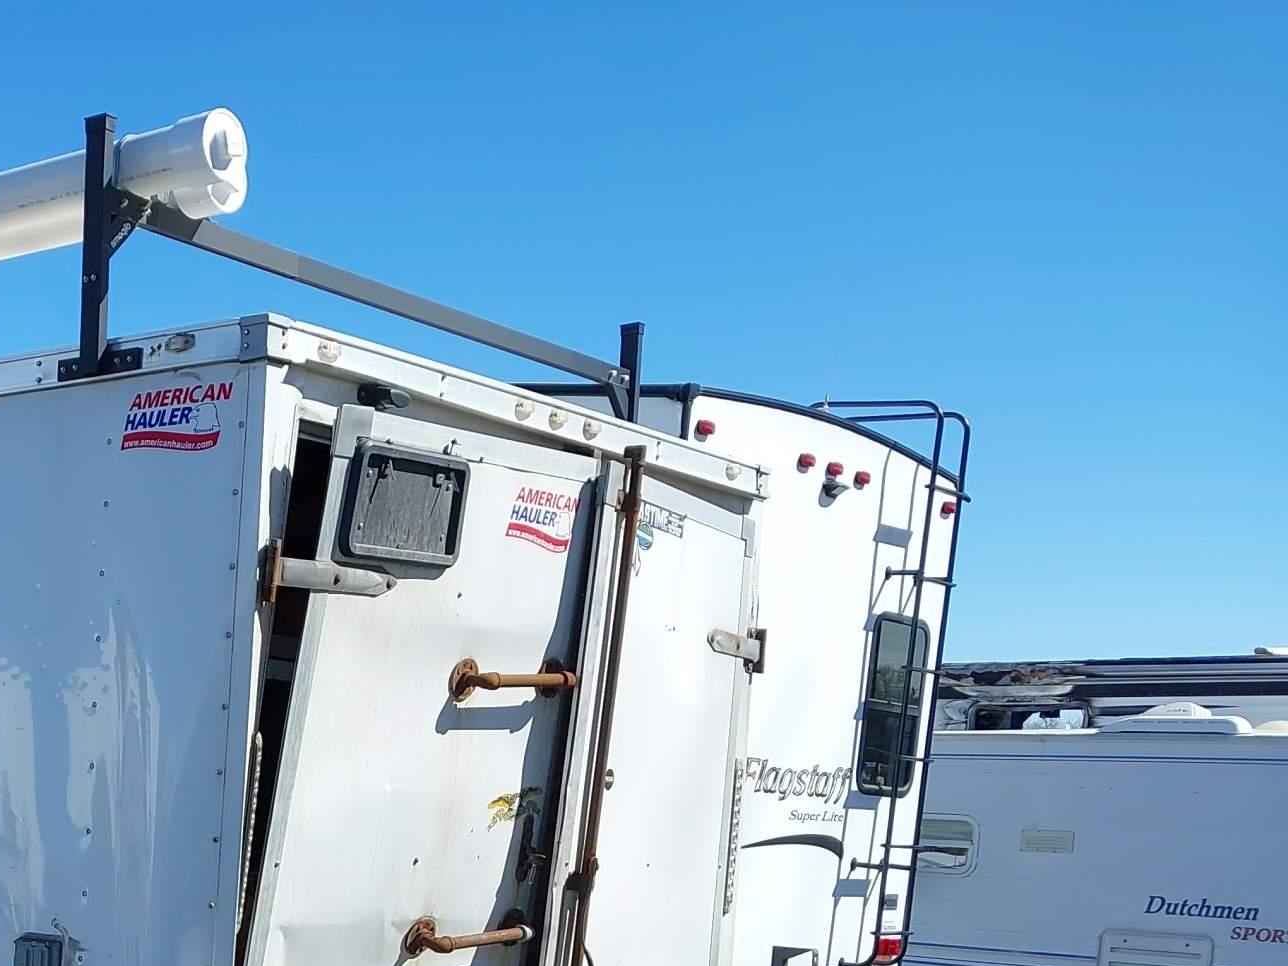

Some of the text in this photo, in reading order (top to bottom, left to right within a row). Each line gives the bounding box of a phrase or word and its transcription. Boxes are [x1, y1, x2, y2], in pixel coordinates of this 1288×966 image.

[129, 382, 233, 411] AMERICAN
[124, 406, 192, 431] HAULER
[123, 438, 214, 449] www.americanhauler.com
[516, 486, 581, 512] AMERICAN
[510, 504, 558, 527] HAULER
[745, 757, 852, 805] Flagstaff
[788, 809, 844, 824] Super Lite
[1144, 895, 1260, 921] Dutchmen
[1230, 926, 1288, 945] SPOR
